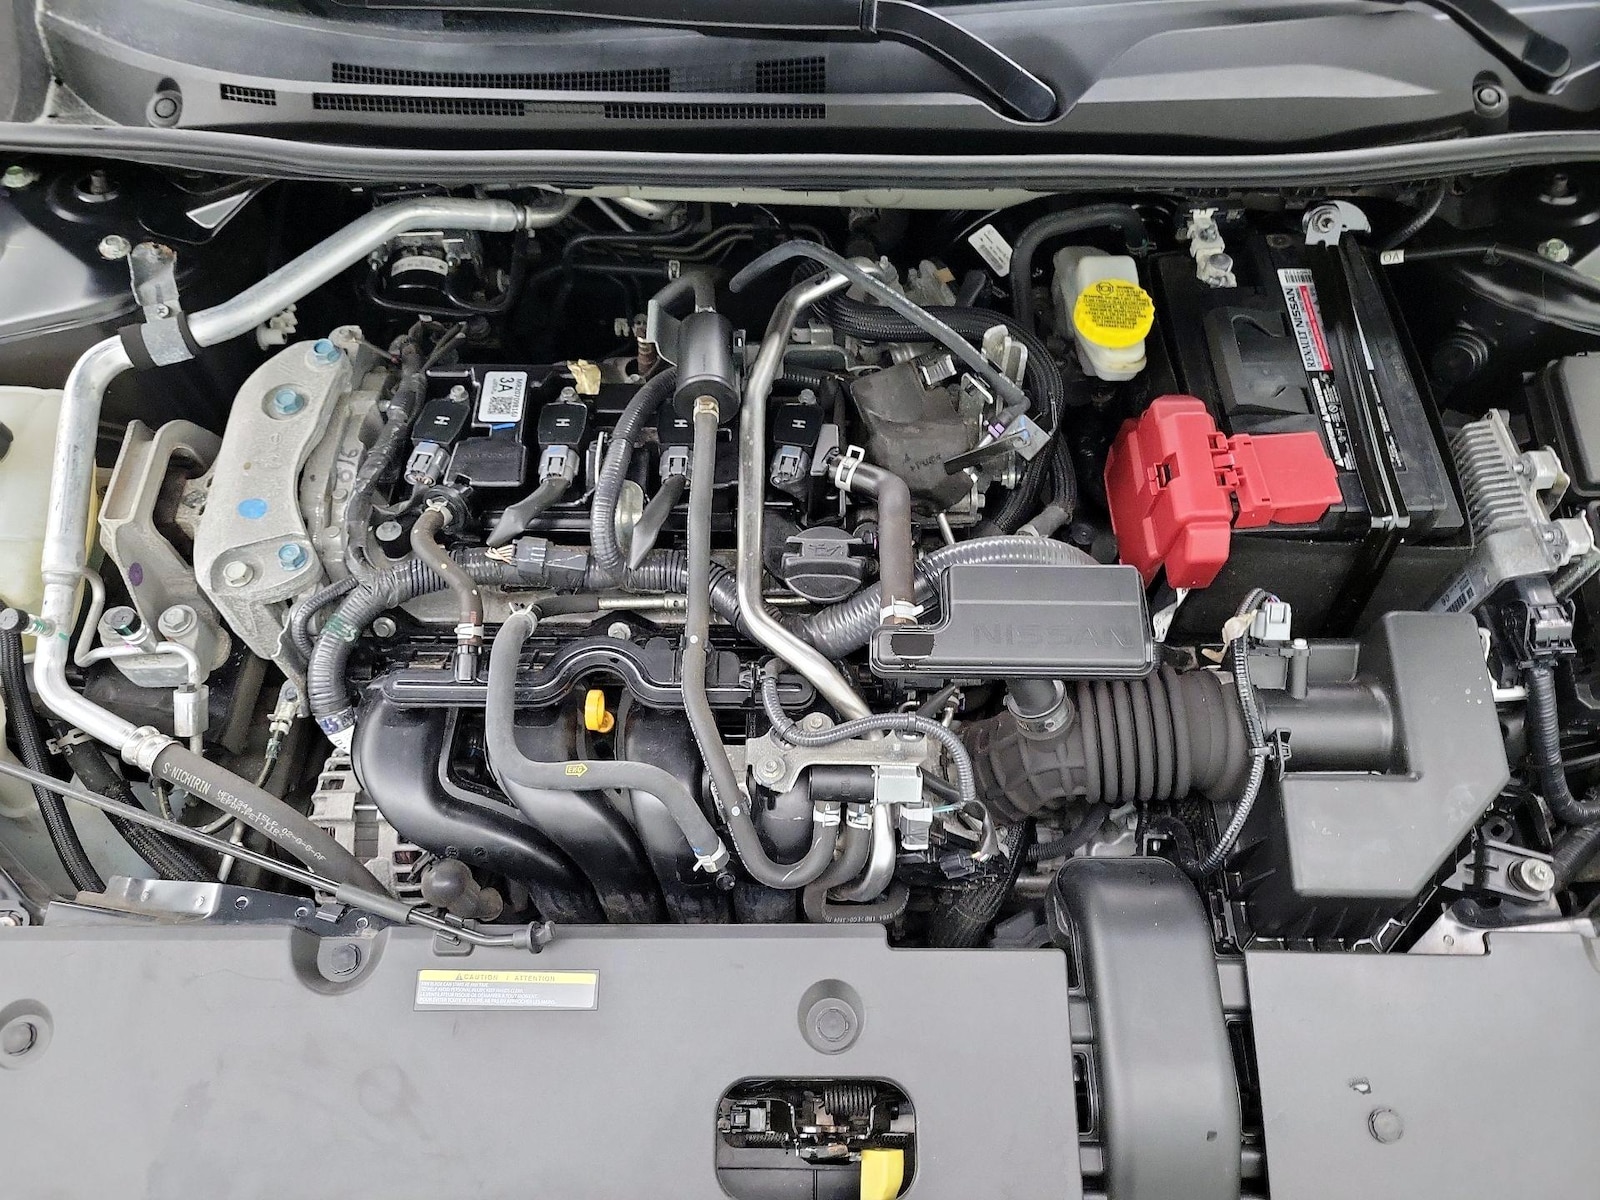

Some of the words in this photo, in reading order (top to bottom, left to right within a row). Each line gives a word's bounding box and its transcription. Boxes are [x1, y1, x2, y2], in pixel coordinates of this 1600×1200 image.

[1285, 287, 1305, 328] NISSAN
[1297, 329, 1317, 368] RENAULT
[497, 377, 515, 393] 3A
[971, 621, 1135, 649] NISSAN
[463, 973, 499, 981] CAUTION
[514, 975, 556, 983] ATTENTION
